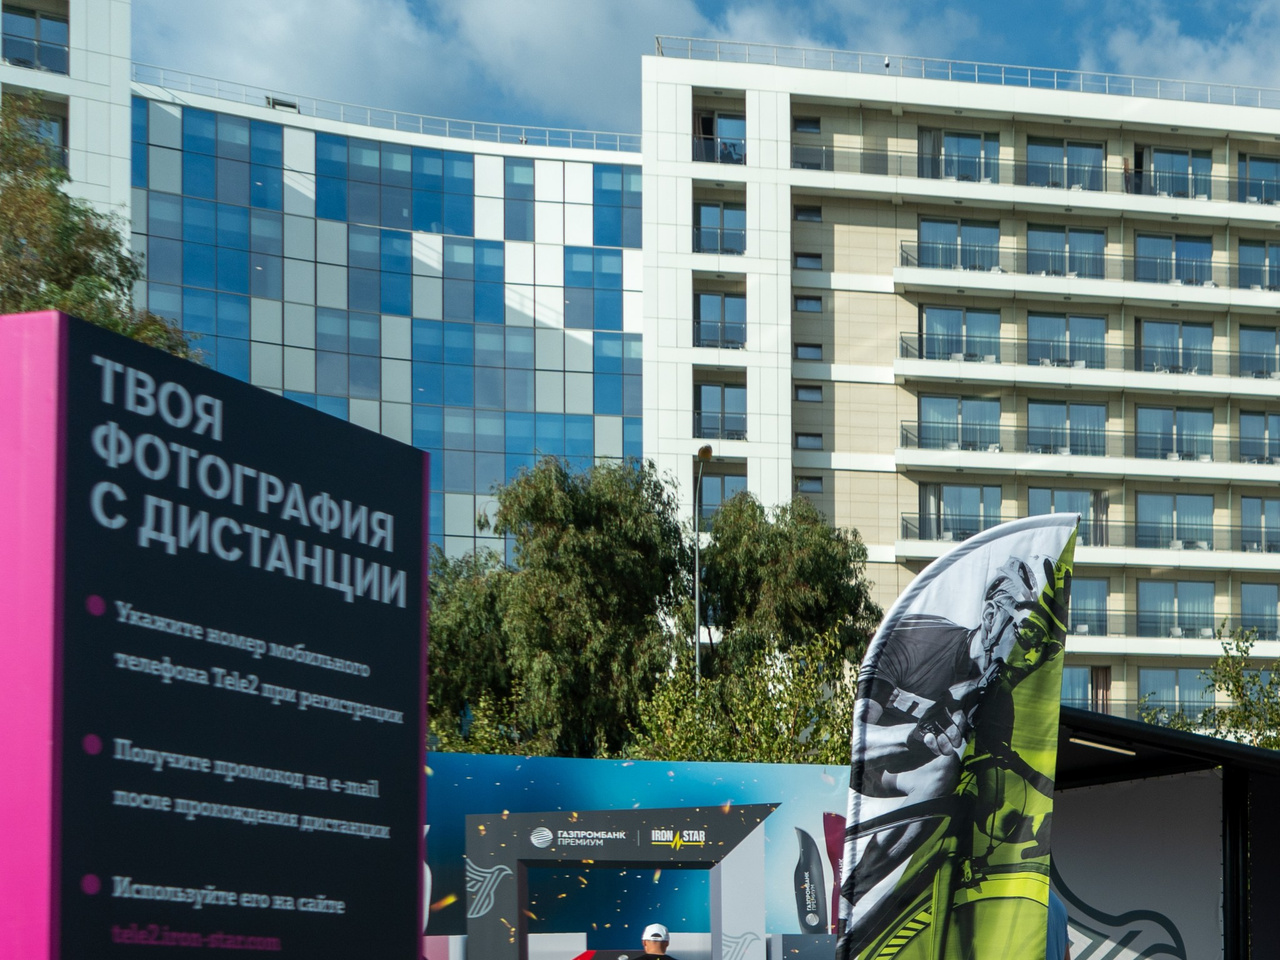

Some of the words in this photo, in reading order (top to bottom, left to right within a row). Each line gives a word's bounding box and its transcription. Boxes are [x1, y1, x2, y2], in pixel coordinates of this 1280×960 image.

[92, 354, 223, 442] ТВОЯ
[92, 421, 394, 552] ФОТОГРАФИЯ
[90, 481, 127, 529] С
[138, 494, 407, 608] ДИСТАНЦИИ
[114, 600, 204, 640] Укажите
[206, 626, 266, 659] номер
[269, 644, 371, 677] мобильного
[114, 652, 209, 684] телефона
[210, 667, 259, 695] Tele2
[261, 682, 297, 705] при
[300, 690, 404, 724] регистрации
[113, 738, 211, 771] Получите
[214, 759, 304, 789] промокод
[306, 777, 328, 791] на
[330, 779, 380, 798] e-mail
[112, 789, 172, 811] после
[174, 798, 298, 827] прохождения
[300, 814, 391, 839] дистанции
[557, 830, 626, 839] ГАЗПРОМБАНК
[651, 830, 673, 841] IRON
[683, 830, 705, 841] STAR
[558, 838, 603, 846] ПРЕМИУМ
[111, 876, 237, 909] Используйте
[240, 893, 270, 909] его
[272, 896, 295, 911] на
[297, 895, 346, 914] сайте
